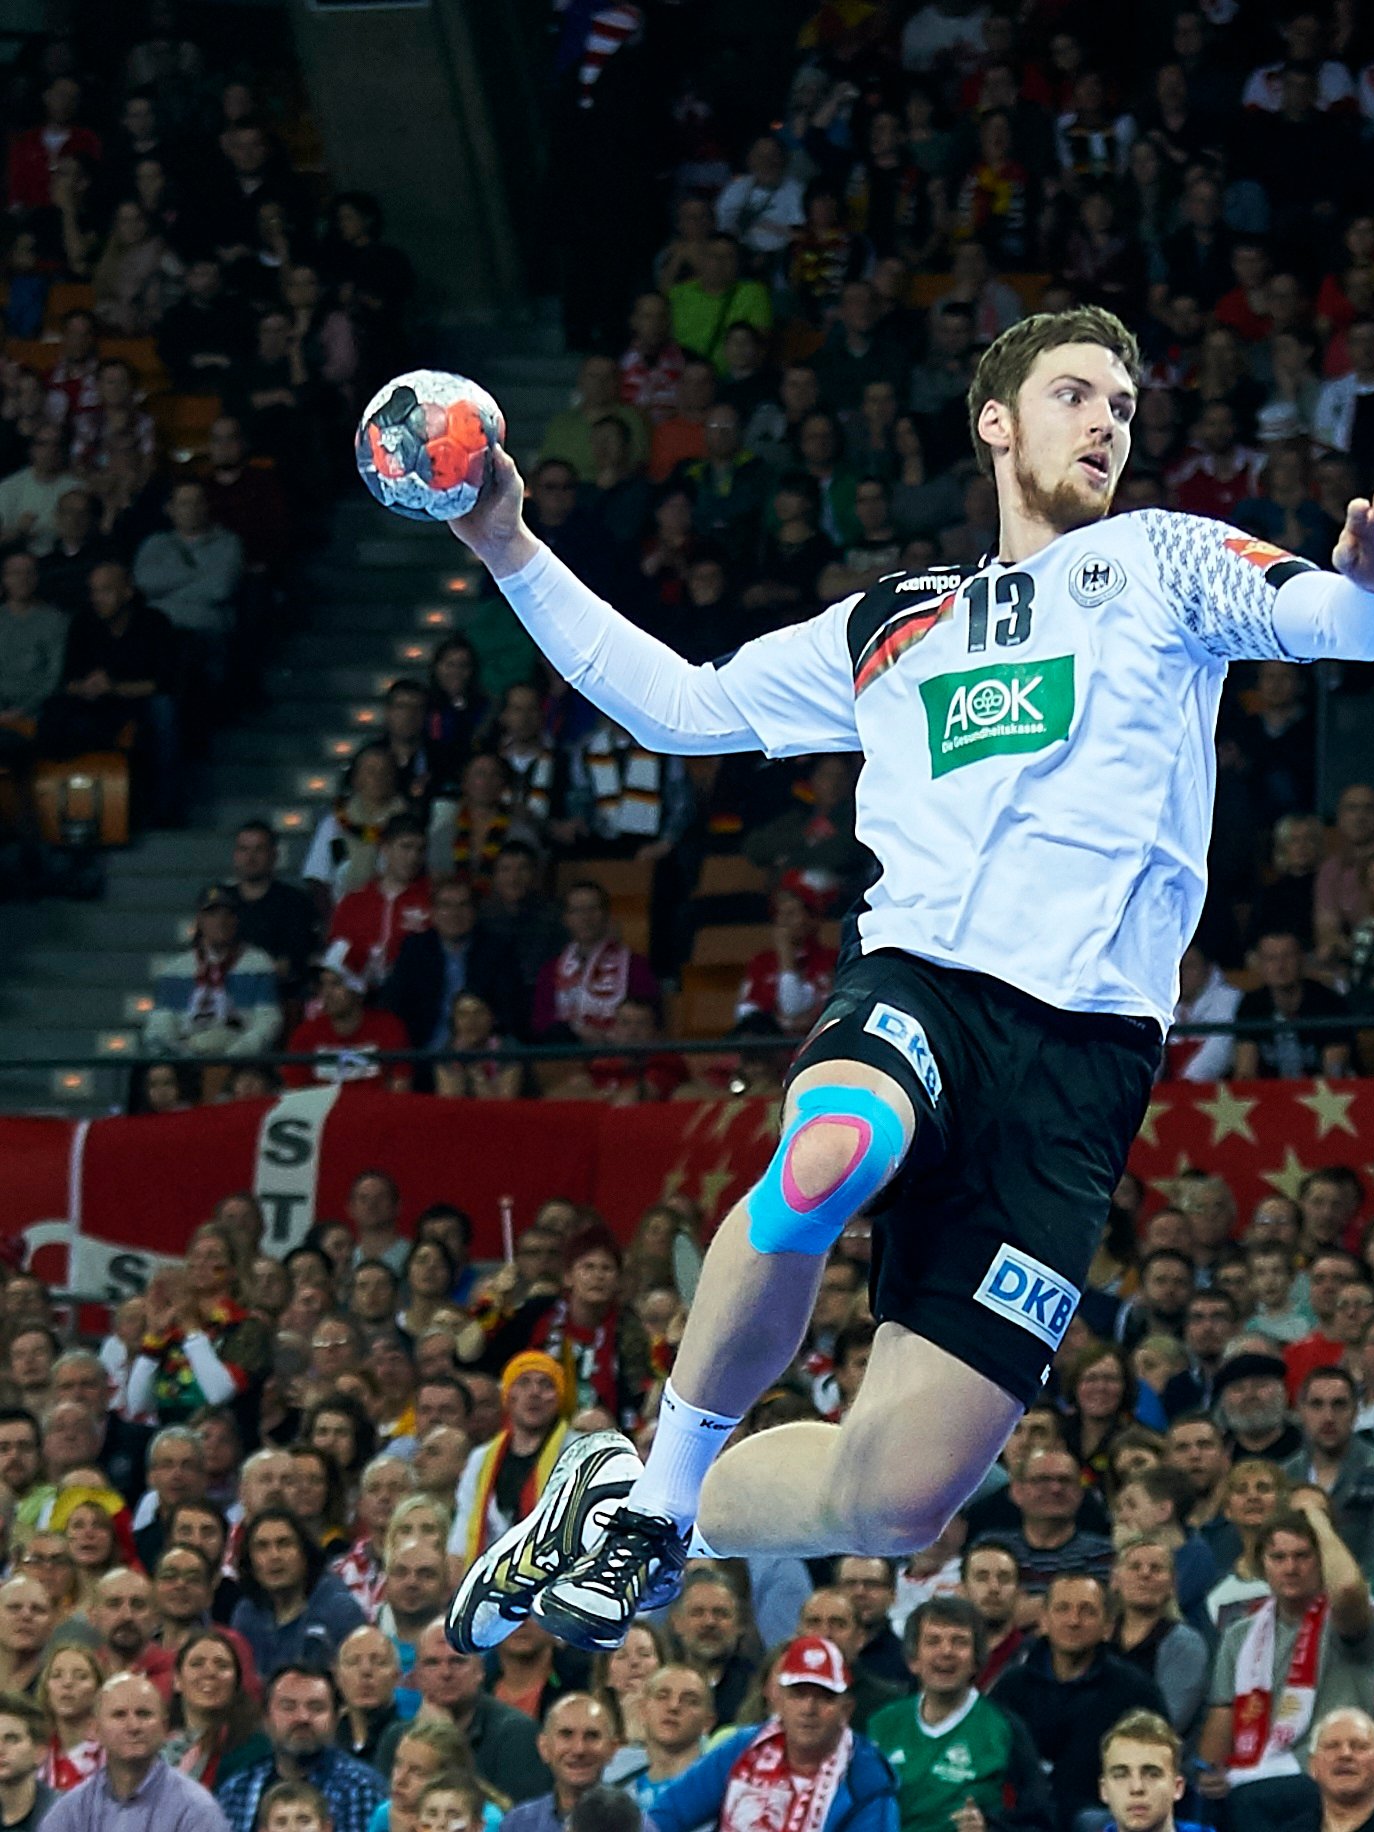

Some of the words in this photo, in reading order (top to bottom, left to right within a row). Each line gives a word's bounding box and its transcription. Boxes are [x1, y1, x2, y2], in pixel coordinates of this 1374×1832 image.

[963, 571, 1036, 654] 13
[943, 676, 1044, 739] AOK
[988, 1259, 1073, 1335] DKB
